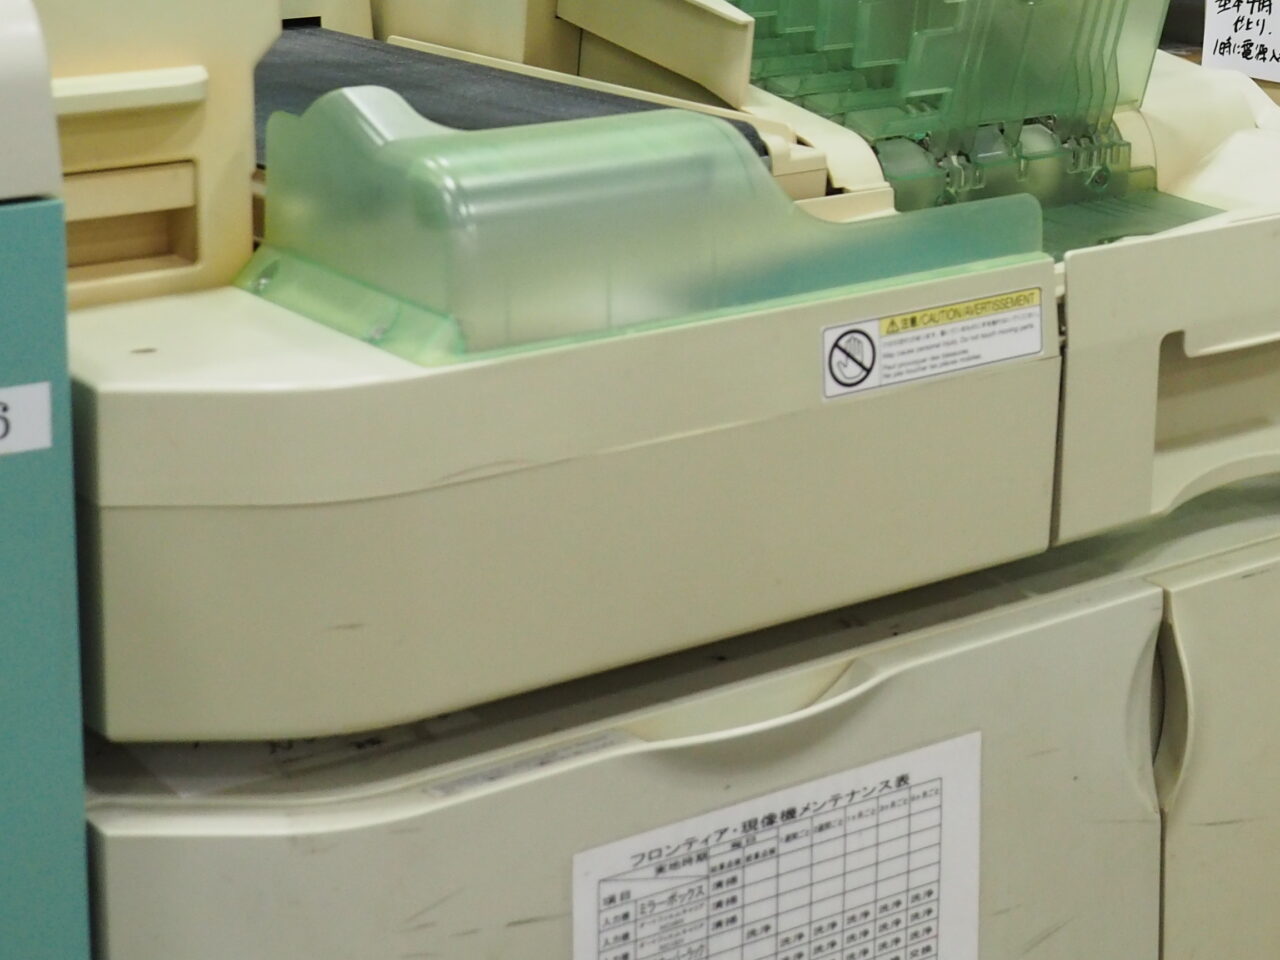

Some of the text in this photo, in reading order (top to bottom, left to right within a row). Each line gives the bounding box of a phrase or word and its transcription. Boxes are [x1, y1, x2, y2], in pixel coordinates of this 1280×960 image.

[630, 773, 910, 868] フロンティア・現像機メンテナンス表
